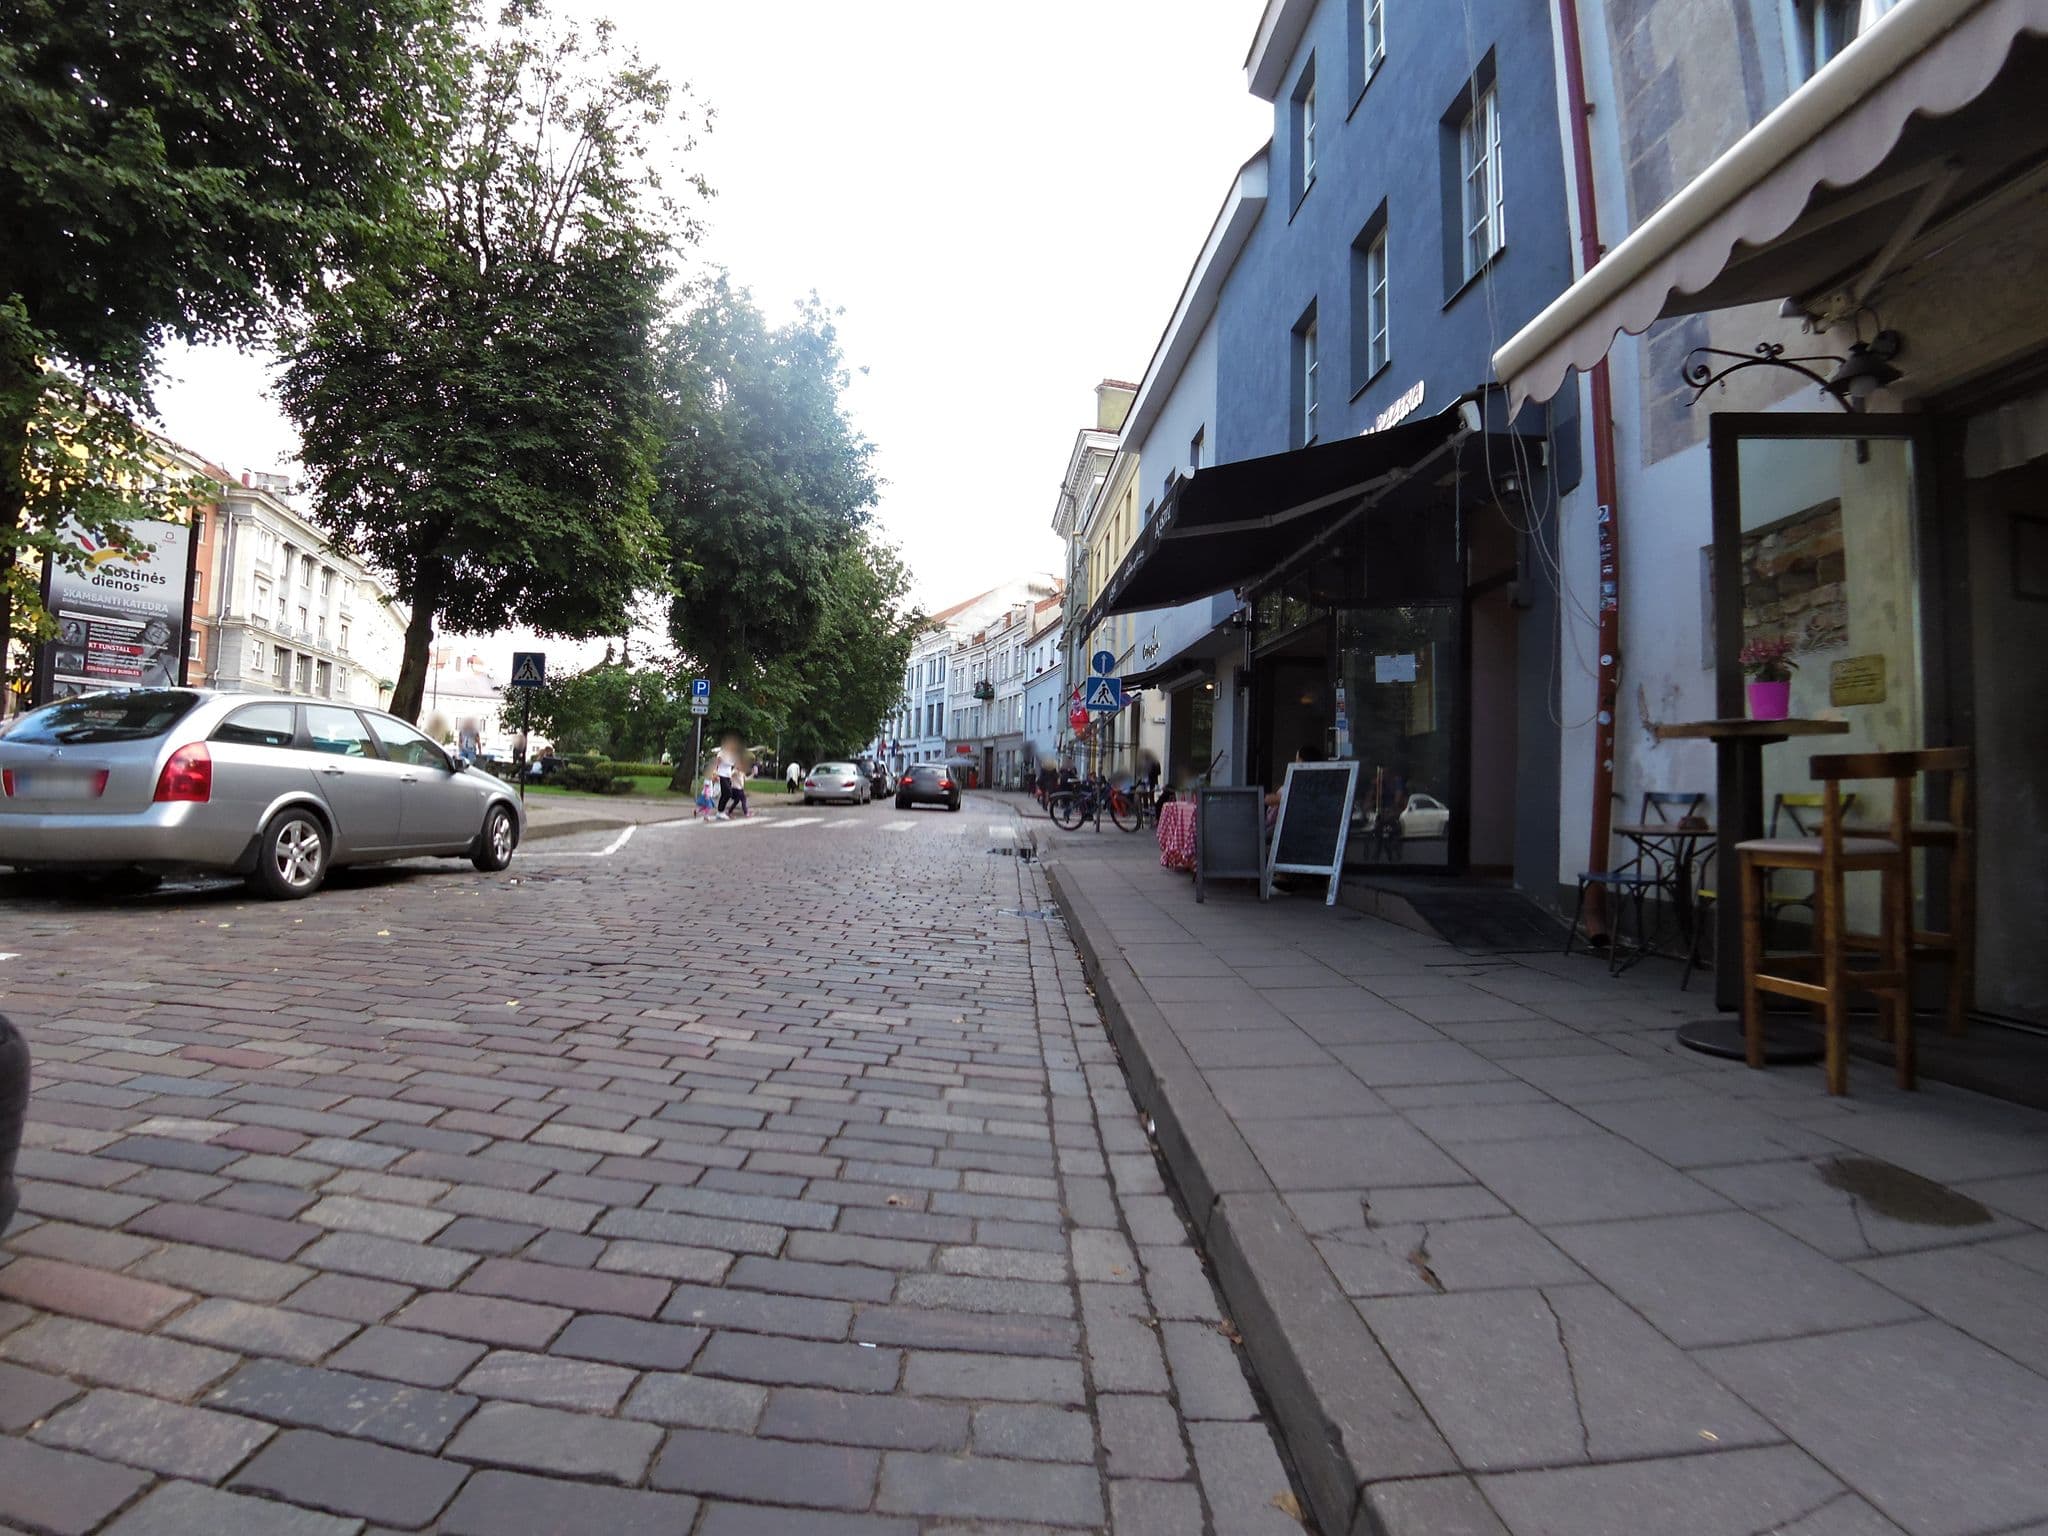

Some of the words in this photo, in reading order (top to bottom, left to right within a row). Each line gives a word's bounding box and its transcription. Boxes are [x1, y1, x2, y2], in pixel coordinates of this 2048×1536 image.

[92, 573, 140, 592] dienos
[63, 588, 120, 605] SKAMBANTI
[121, 597, 169, 613] KATEDRA
[98, 643, 131, 653] TUNSTALL
[697, 681, 706, 694] P
